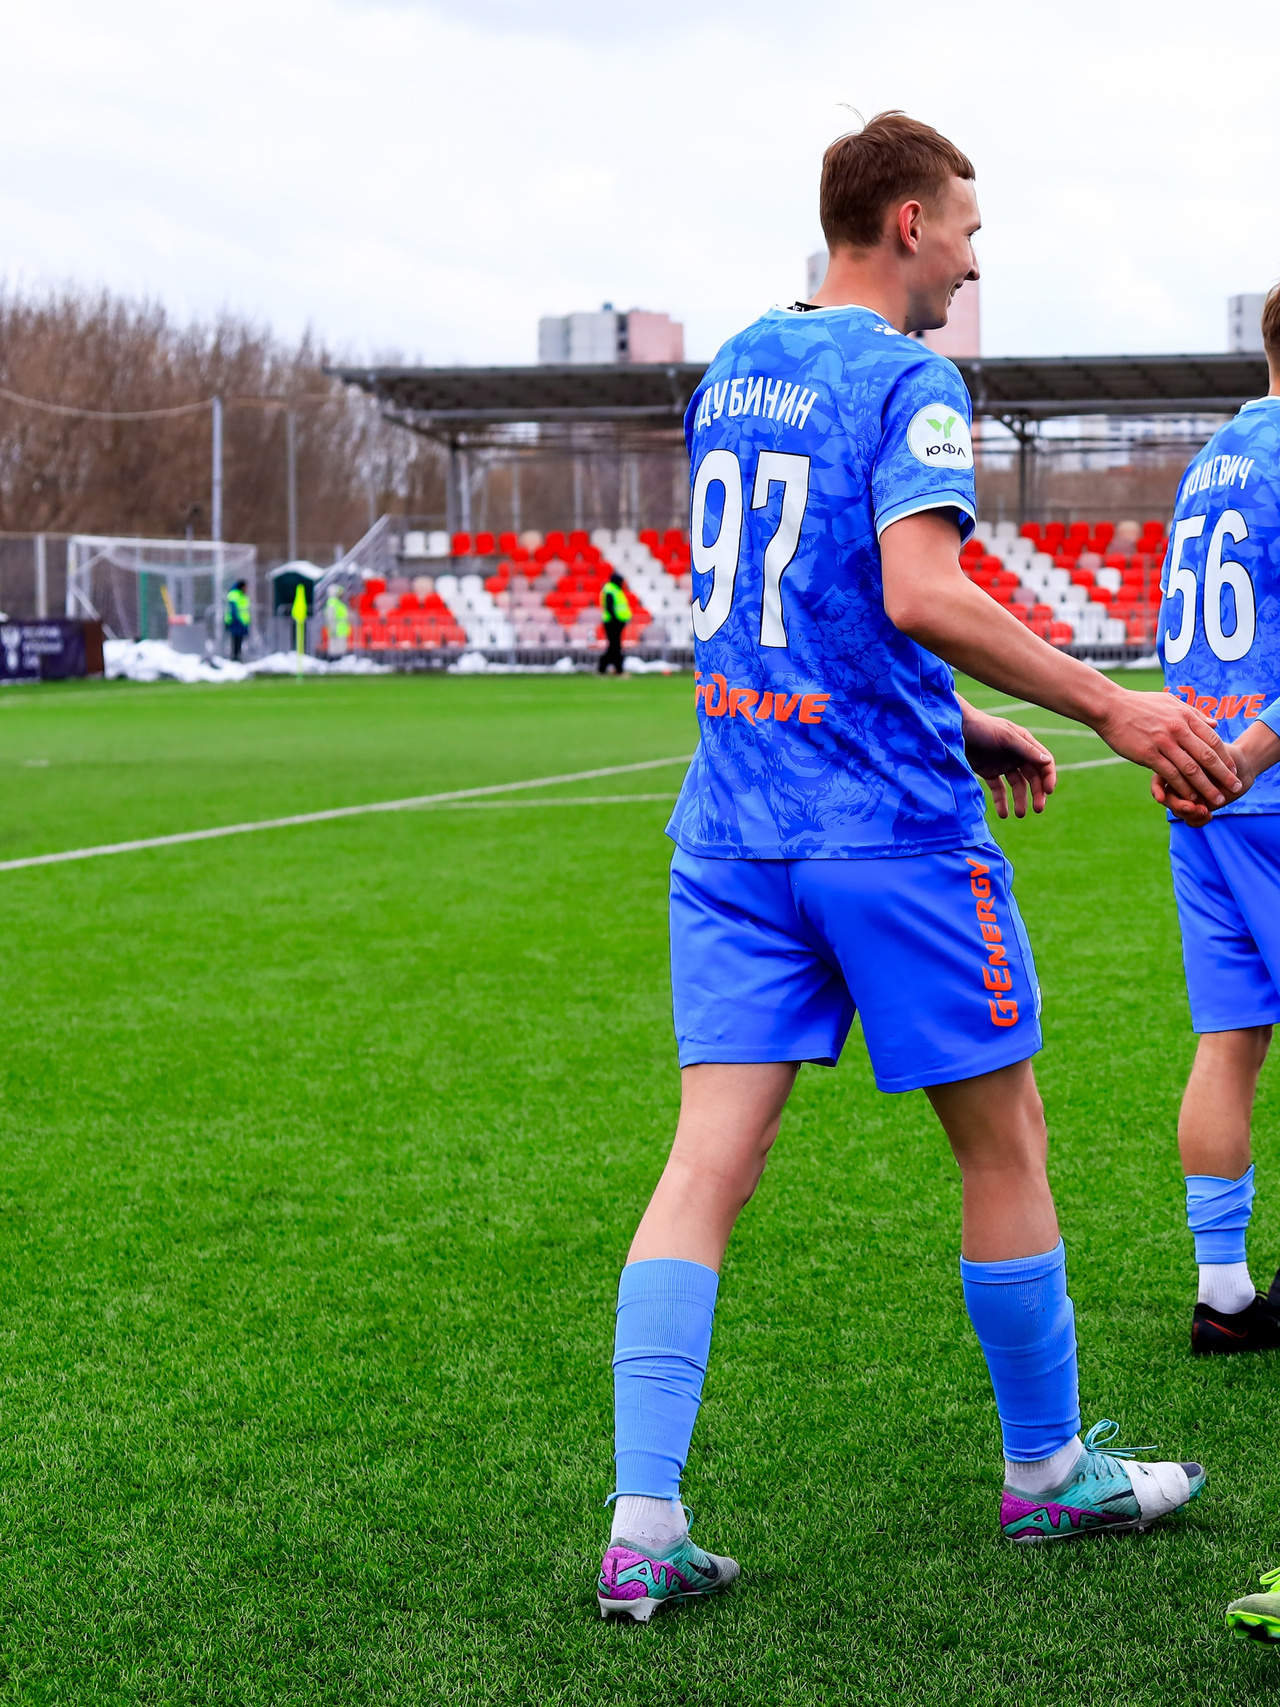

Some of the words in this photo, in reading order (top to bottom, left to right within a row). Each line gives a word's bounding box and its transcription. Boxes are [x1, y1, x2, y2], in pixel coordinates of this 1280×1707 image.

[697, 376, 818, 432] ДУБИНИН
[926, 443, 966, 458] ЮФЛ
[692, 449, 811, 649] 97
[1164, 509, 1257, 665] 56
